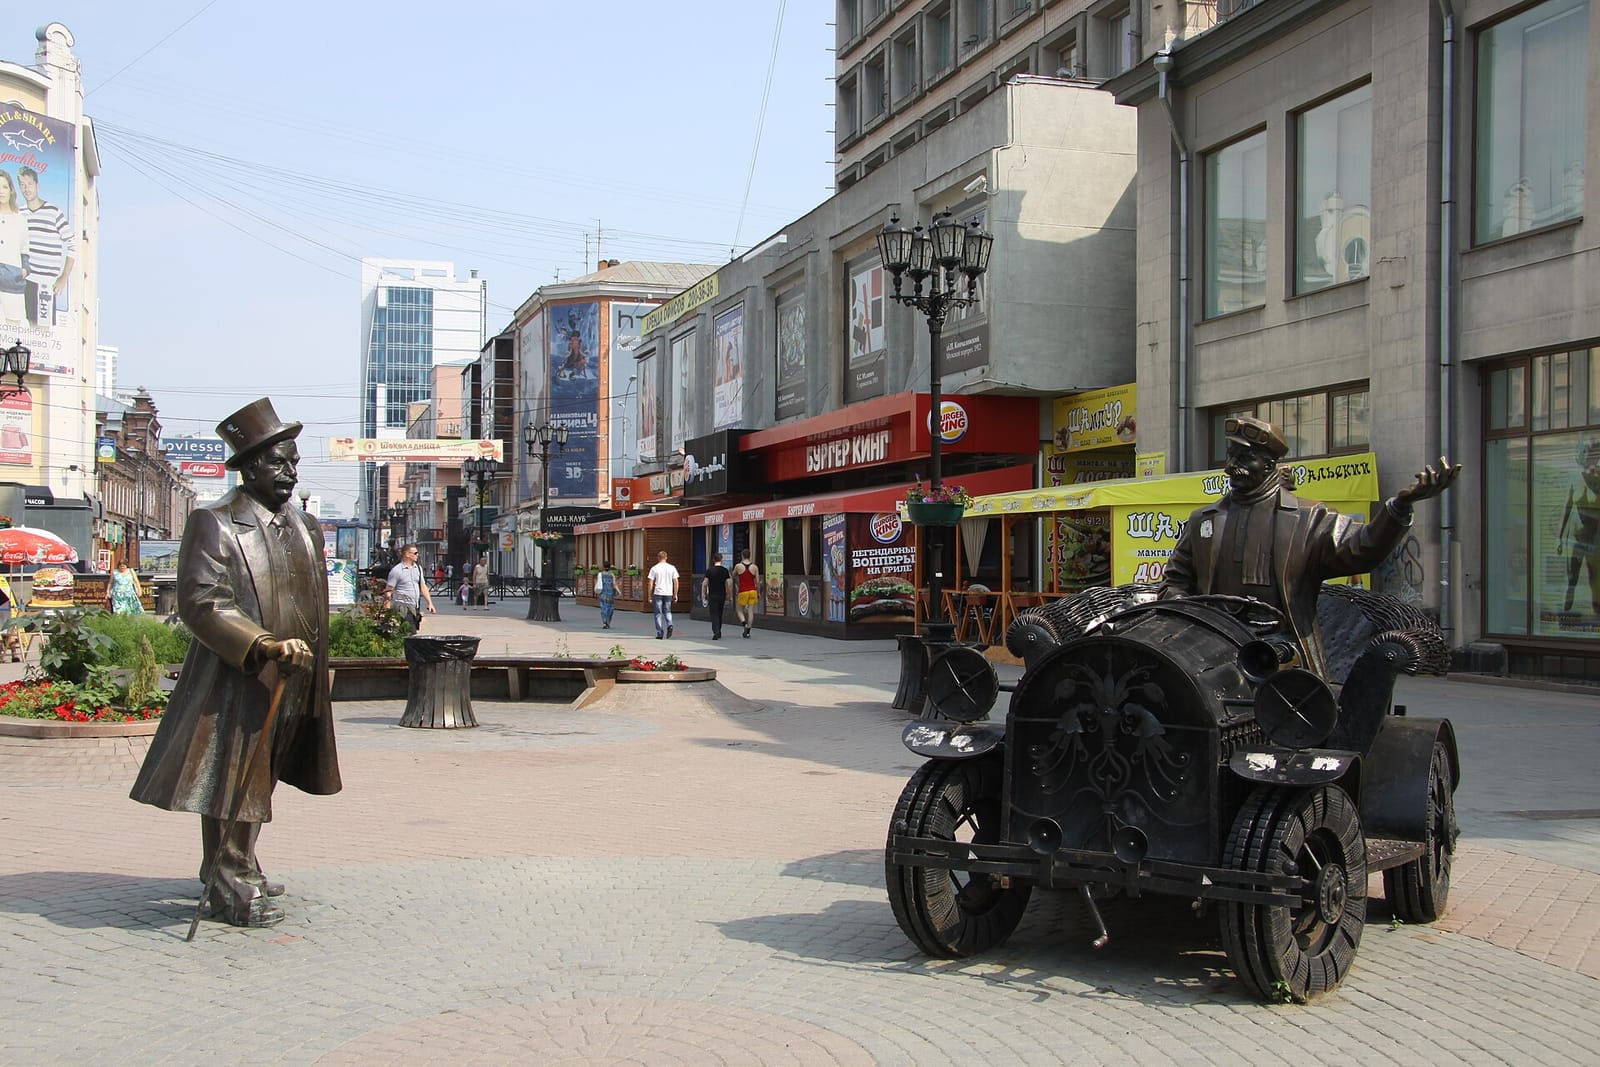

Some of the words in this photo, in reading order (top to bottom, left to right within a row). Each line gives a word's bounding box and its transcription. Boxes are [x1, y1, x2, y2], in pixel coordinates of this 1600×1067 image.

[22, 112, 56, 145] SHARK
[940, 410, 965, 422] URGER
[1068, 400, 1122, 434] ШАМПУР
[166, 440, 223, 452] oviesse
[806, 438, 851, 473] БУРГЕР
[852, 429, 891, 465] КИНГ
[873, 514, 897, 530] BURGER
[875, 520, 899, 537] KING
[852, 554, 916, 568] ВОППЕРЫ
[867, 567, 880, 575] НА
[882, 564, 913, 574] ГРИЛЕ
